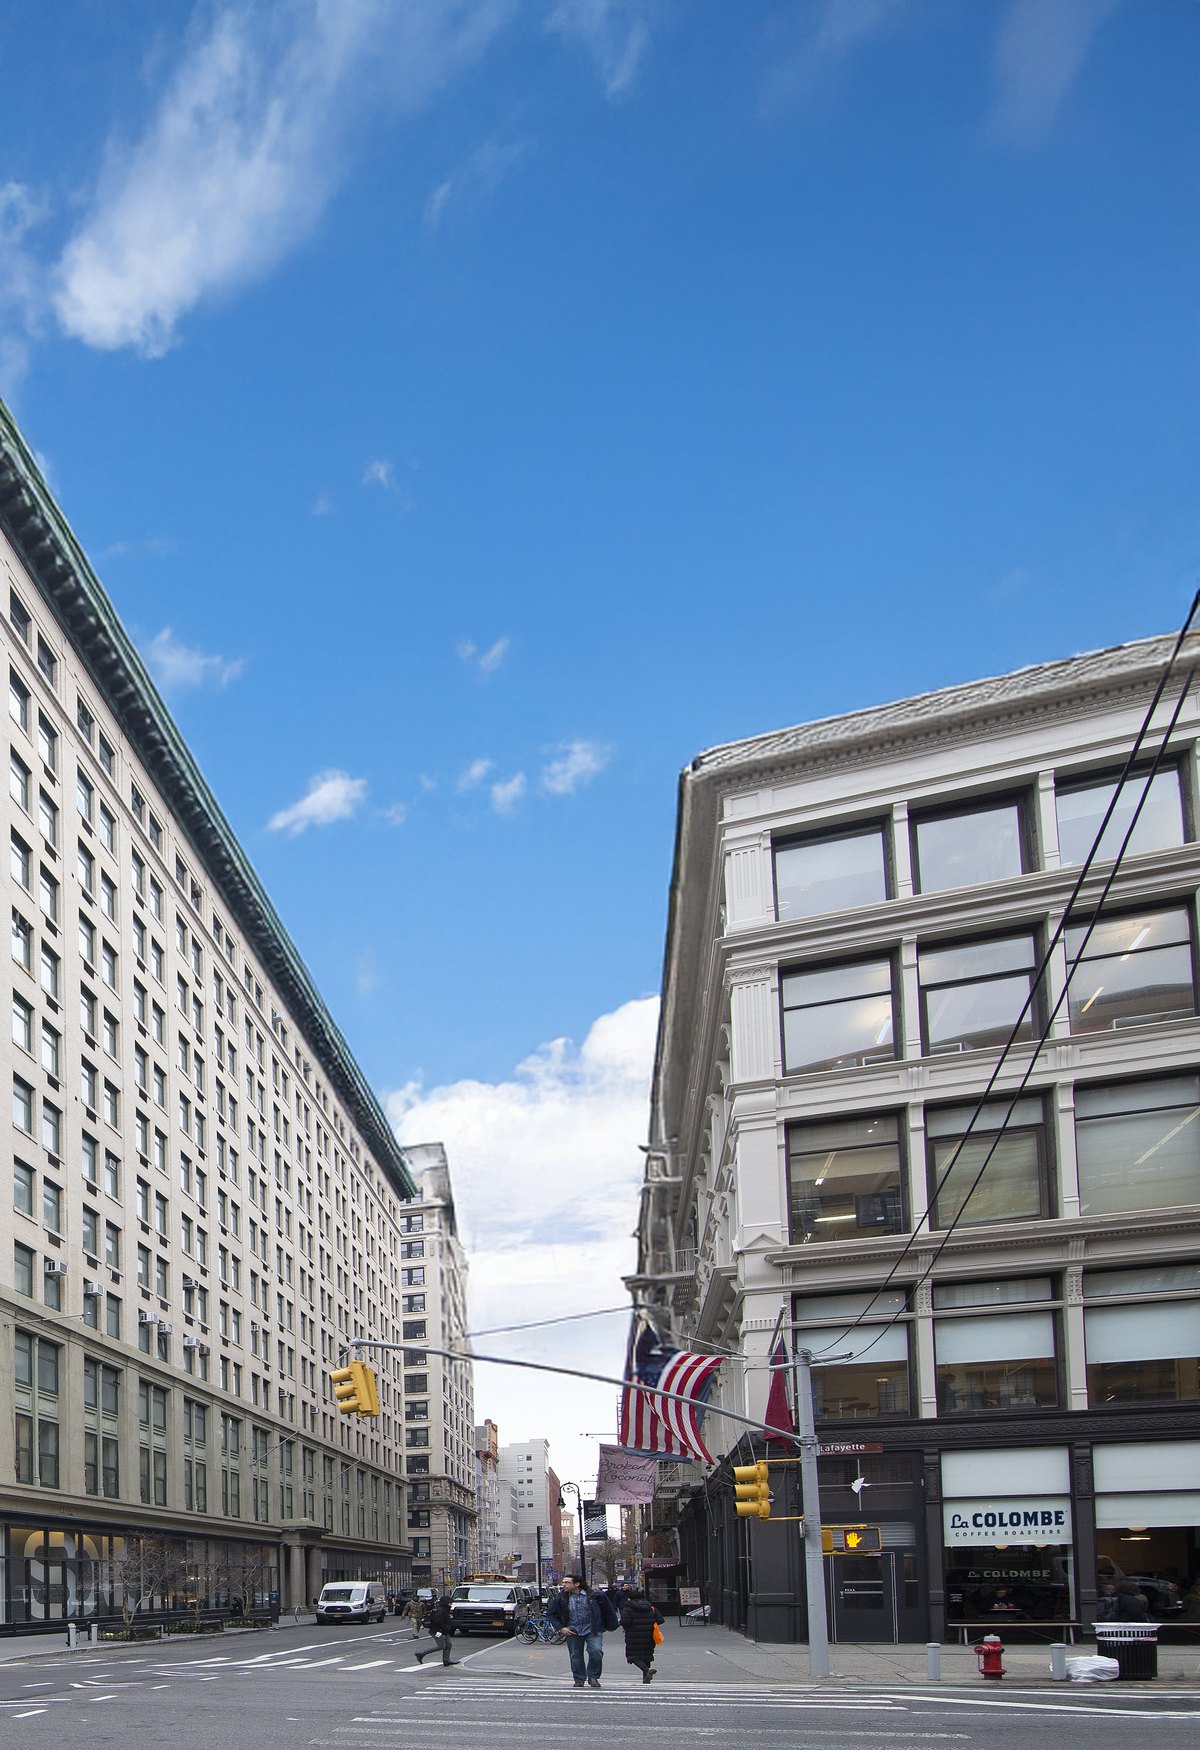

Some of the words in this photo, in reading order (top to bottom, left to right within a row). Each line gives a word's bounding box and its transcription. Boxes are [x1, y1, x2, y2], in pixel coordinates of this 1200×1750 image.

[820, 1443, 865, 1452] Lafayette
[600, 1459, 647, 1472] Broken
[605, 1470, 653, 1484] Coconut
[951, 1514, 969, 1528] La
[972, 1510, 1065, 1528] COLOMBE
[983, 1569, 1050, 1578] COLOMBE
